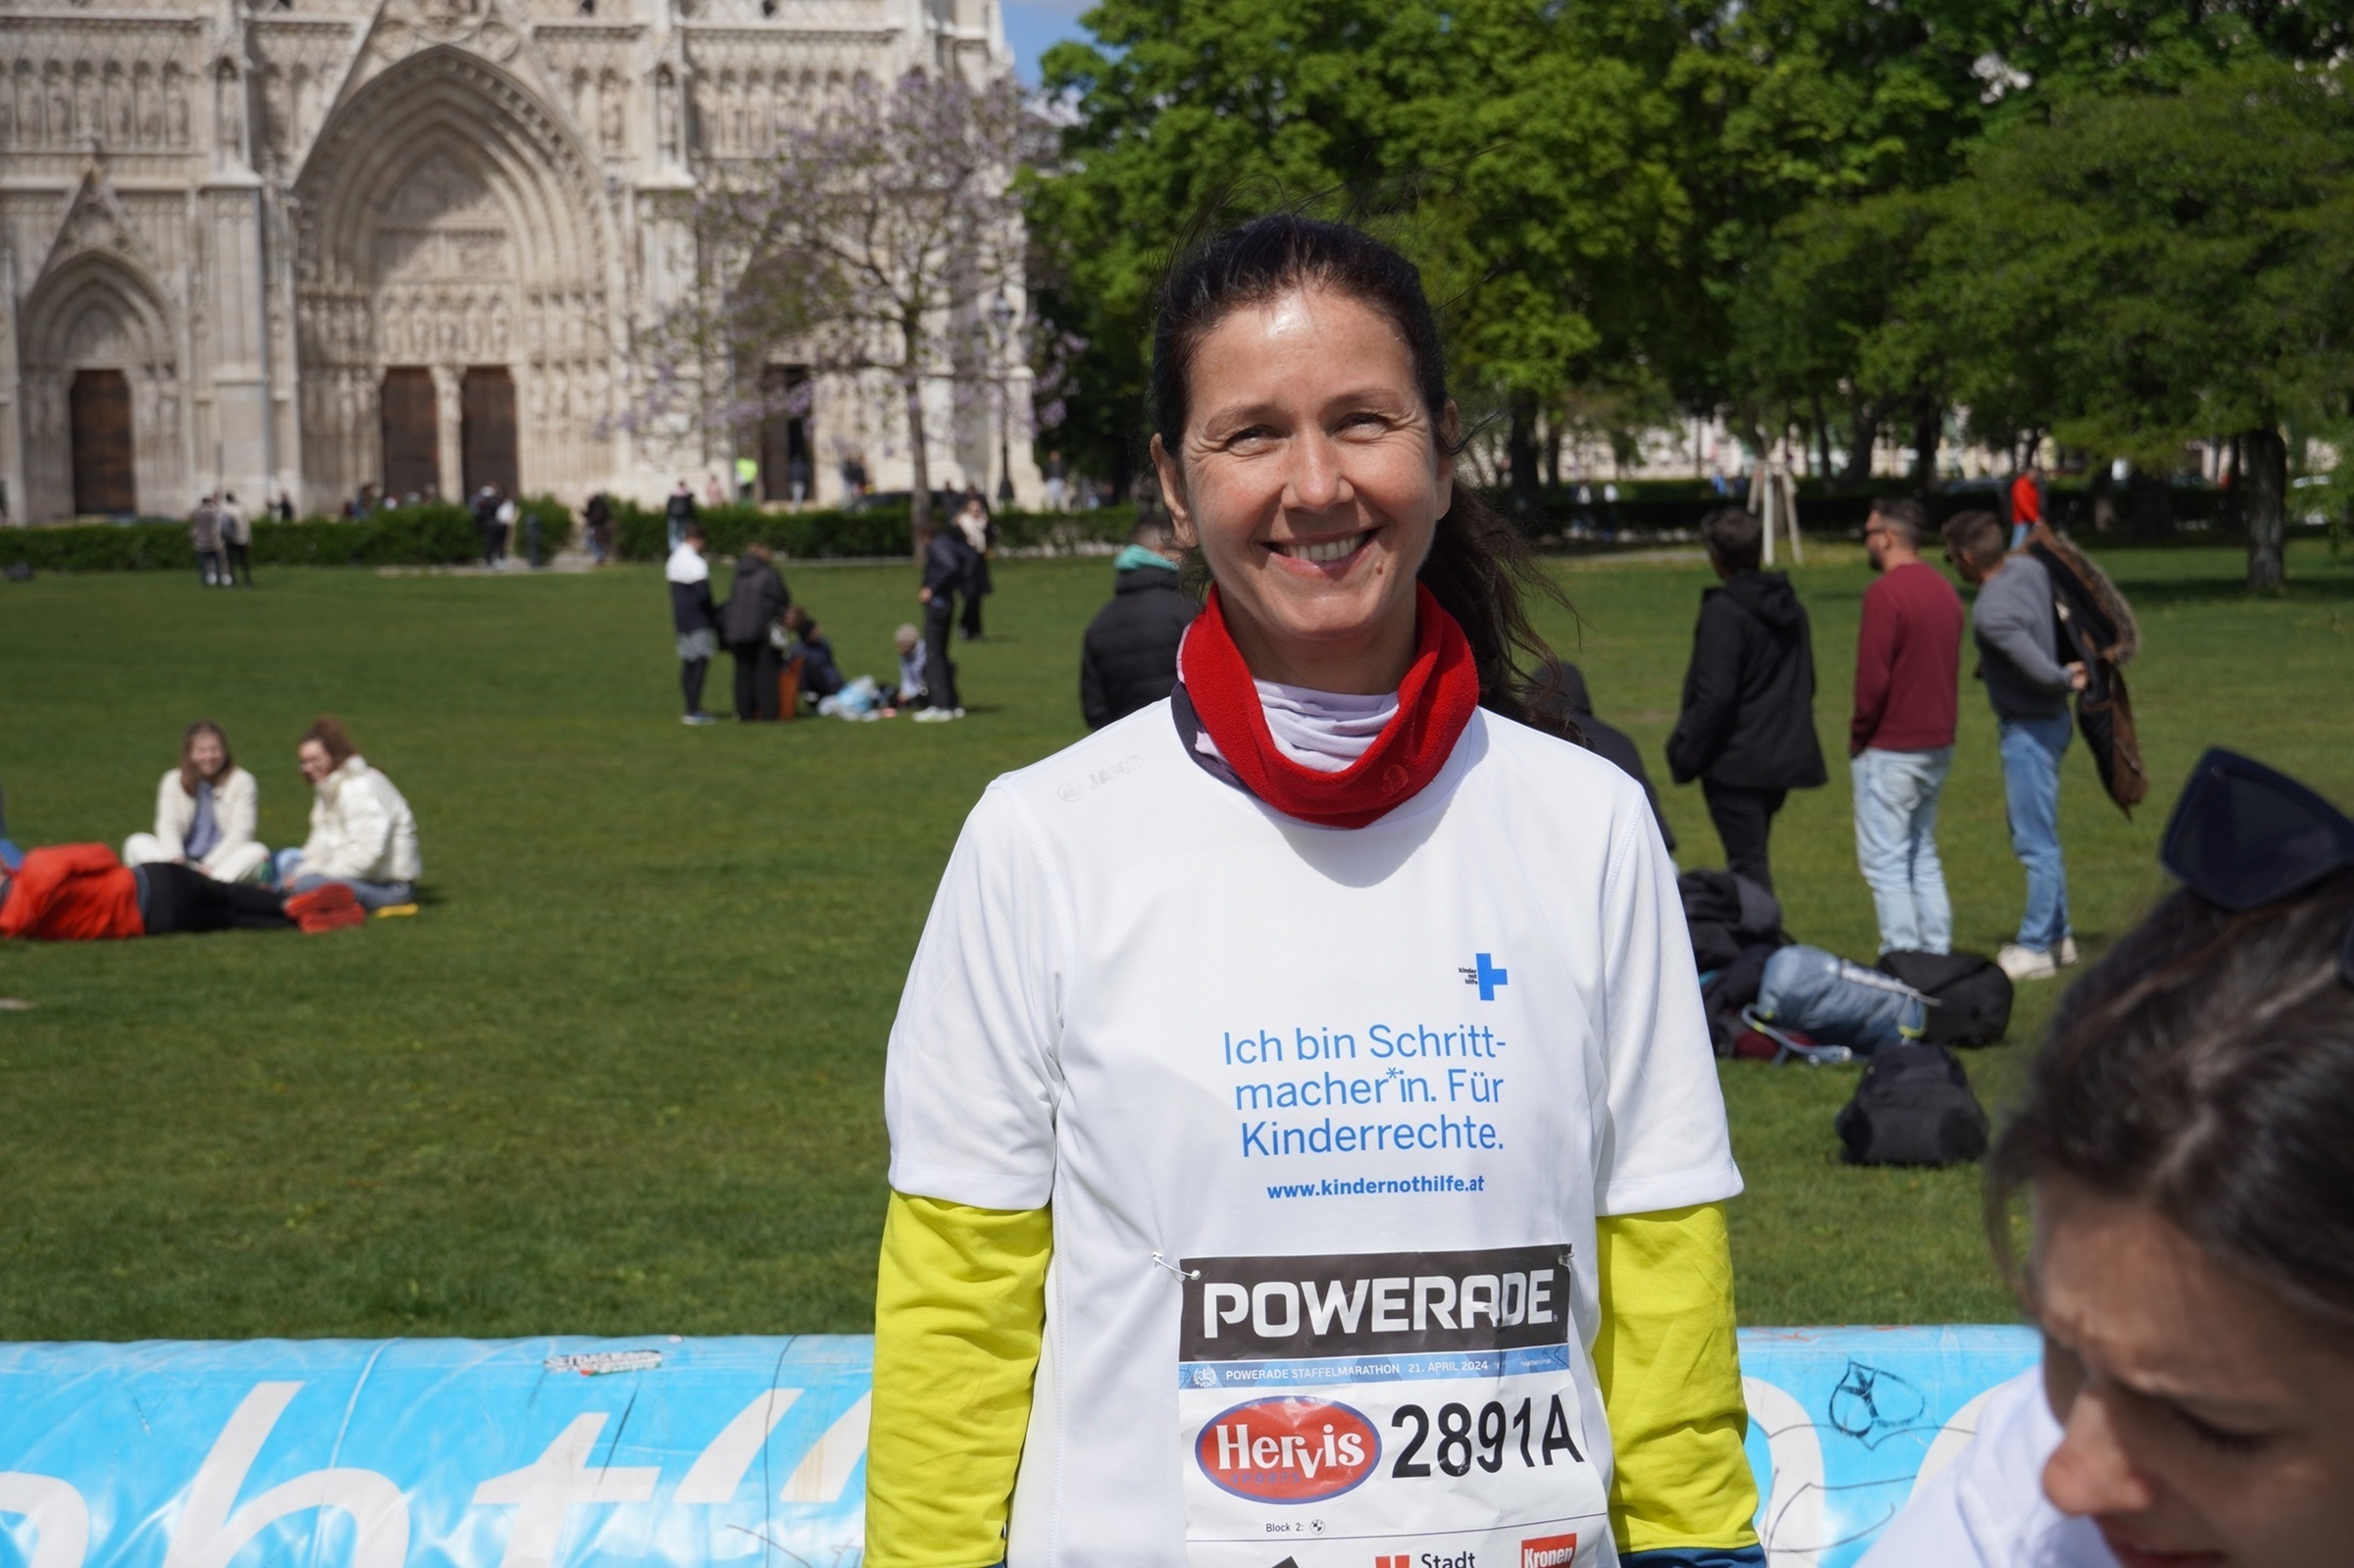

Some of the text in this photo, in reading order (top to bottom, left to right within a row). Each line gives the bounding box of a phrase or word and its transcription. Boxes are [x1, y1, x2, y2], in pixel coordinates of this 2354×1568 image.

[1224, 1024, 1507, 1065] Ich bin Schritt-
[1448, 1068, 1505, 1103] Für
[1241, 1114, 1505, 1157] Kinderrechte.
[1266, 1175, 1485, 1199] www.kindernothilfe.at
[1203, 1269, 1555, 1340] POWERADE
[1226, 1369, 1289, 1381] POWERADE
[1291, 1363, 1401, 1380] STAFFELMARATHON
[1407, 1363, 1425, 1373] 21.
[1428, 1361, 1458, 1372] APRIL
[1461, 1360, 1489, 1371] 2024
[1391, 1393, 1585, 1479] 2891A
[1215, 1424, 1365, 1479] Hervis
[1230, 1471, 1301, 1486] SPORTS
[1266, 1523, 1291, 1533] Block
[1295, 1523, 1304, 1532] 2:
[1420, 1550, 1476, 1568] Stadt
[1524, 1545, 1573, 1568] Kronen
